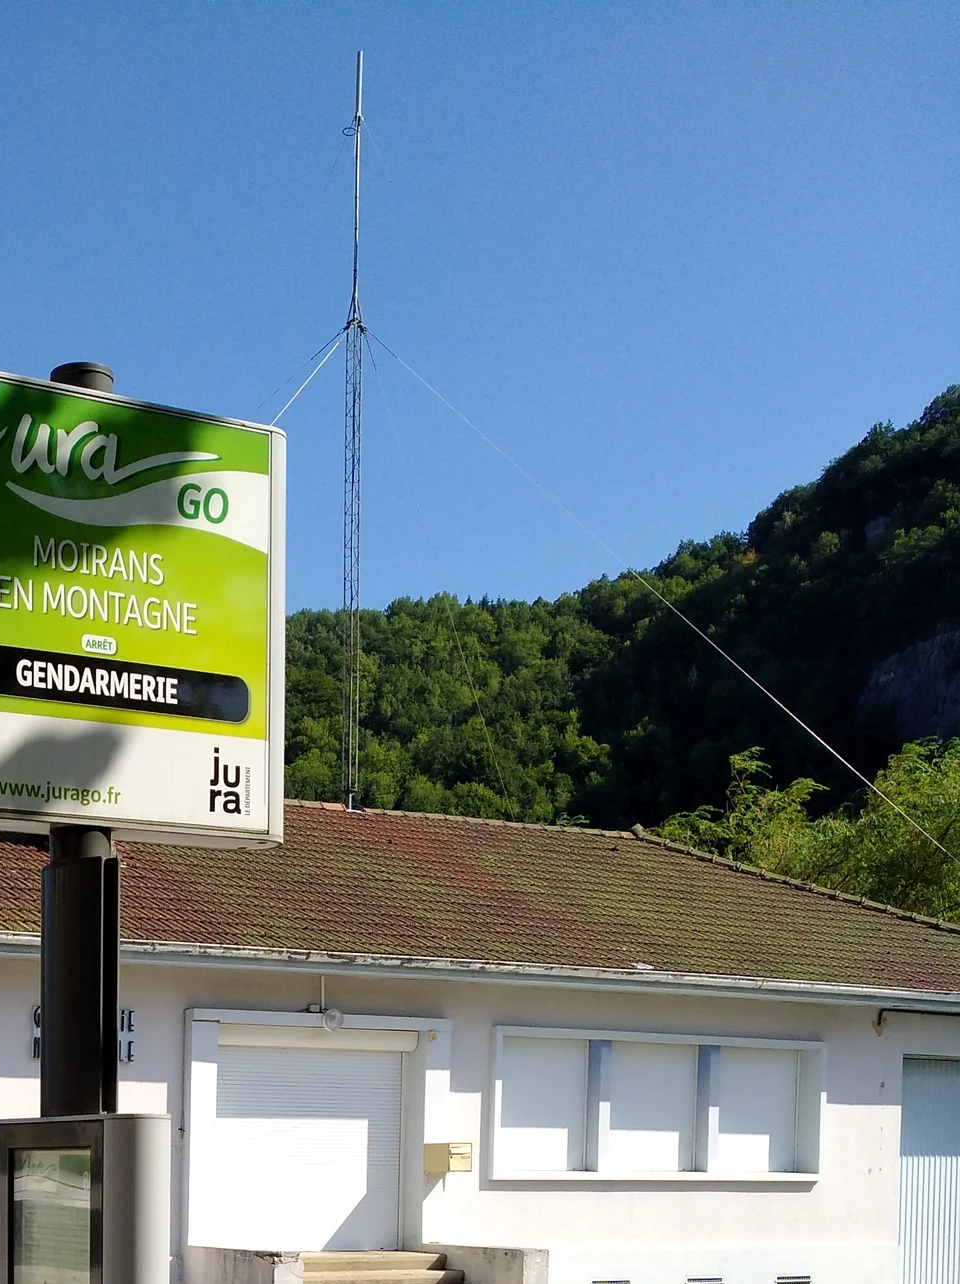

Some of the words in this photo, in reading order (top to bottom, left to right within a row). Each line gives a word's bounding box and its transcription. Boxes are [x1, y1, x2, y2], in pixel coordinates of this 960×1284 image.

[177, 482, 229, 524] GO
[33, 534, 165, 586] MOIRANS
[42, 581, 198, 635] MONTAGNE
[85, 638, 113, 652] ARRÊT
[16, 658, 179, 705] GENDARMERIE
